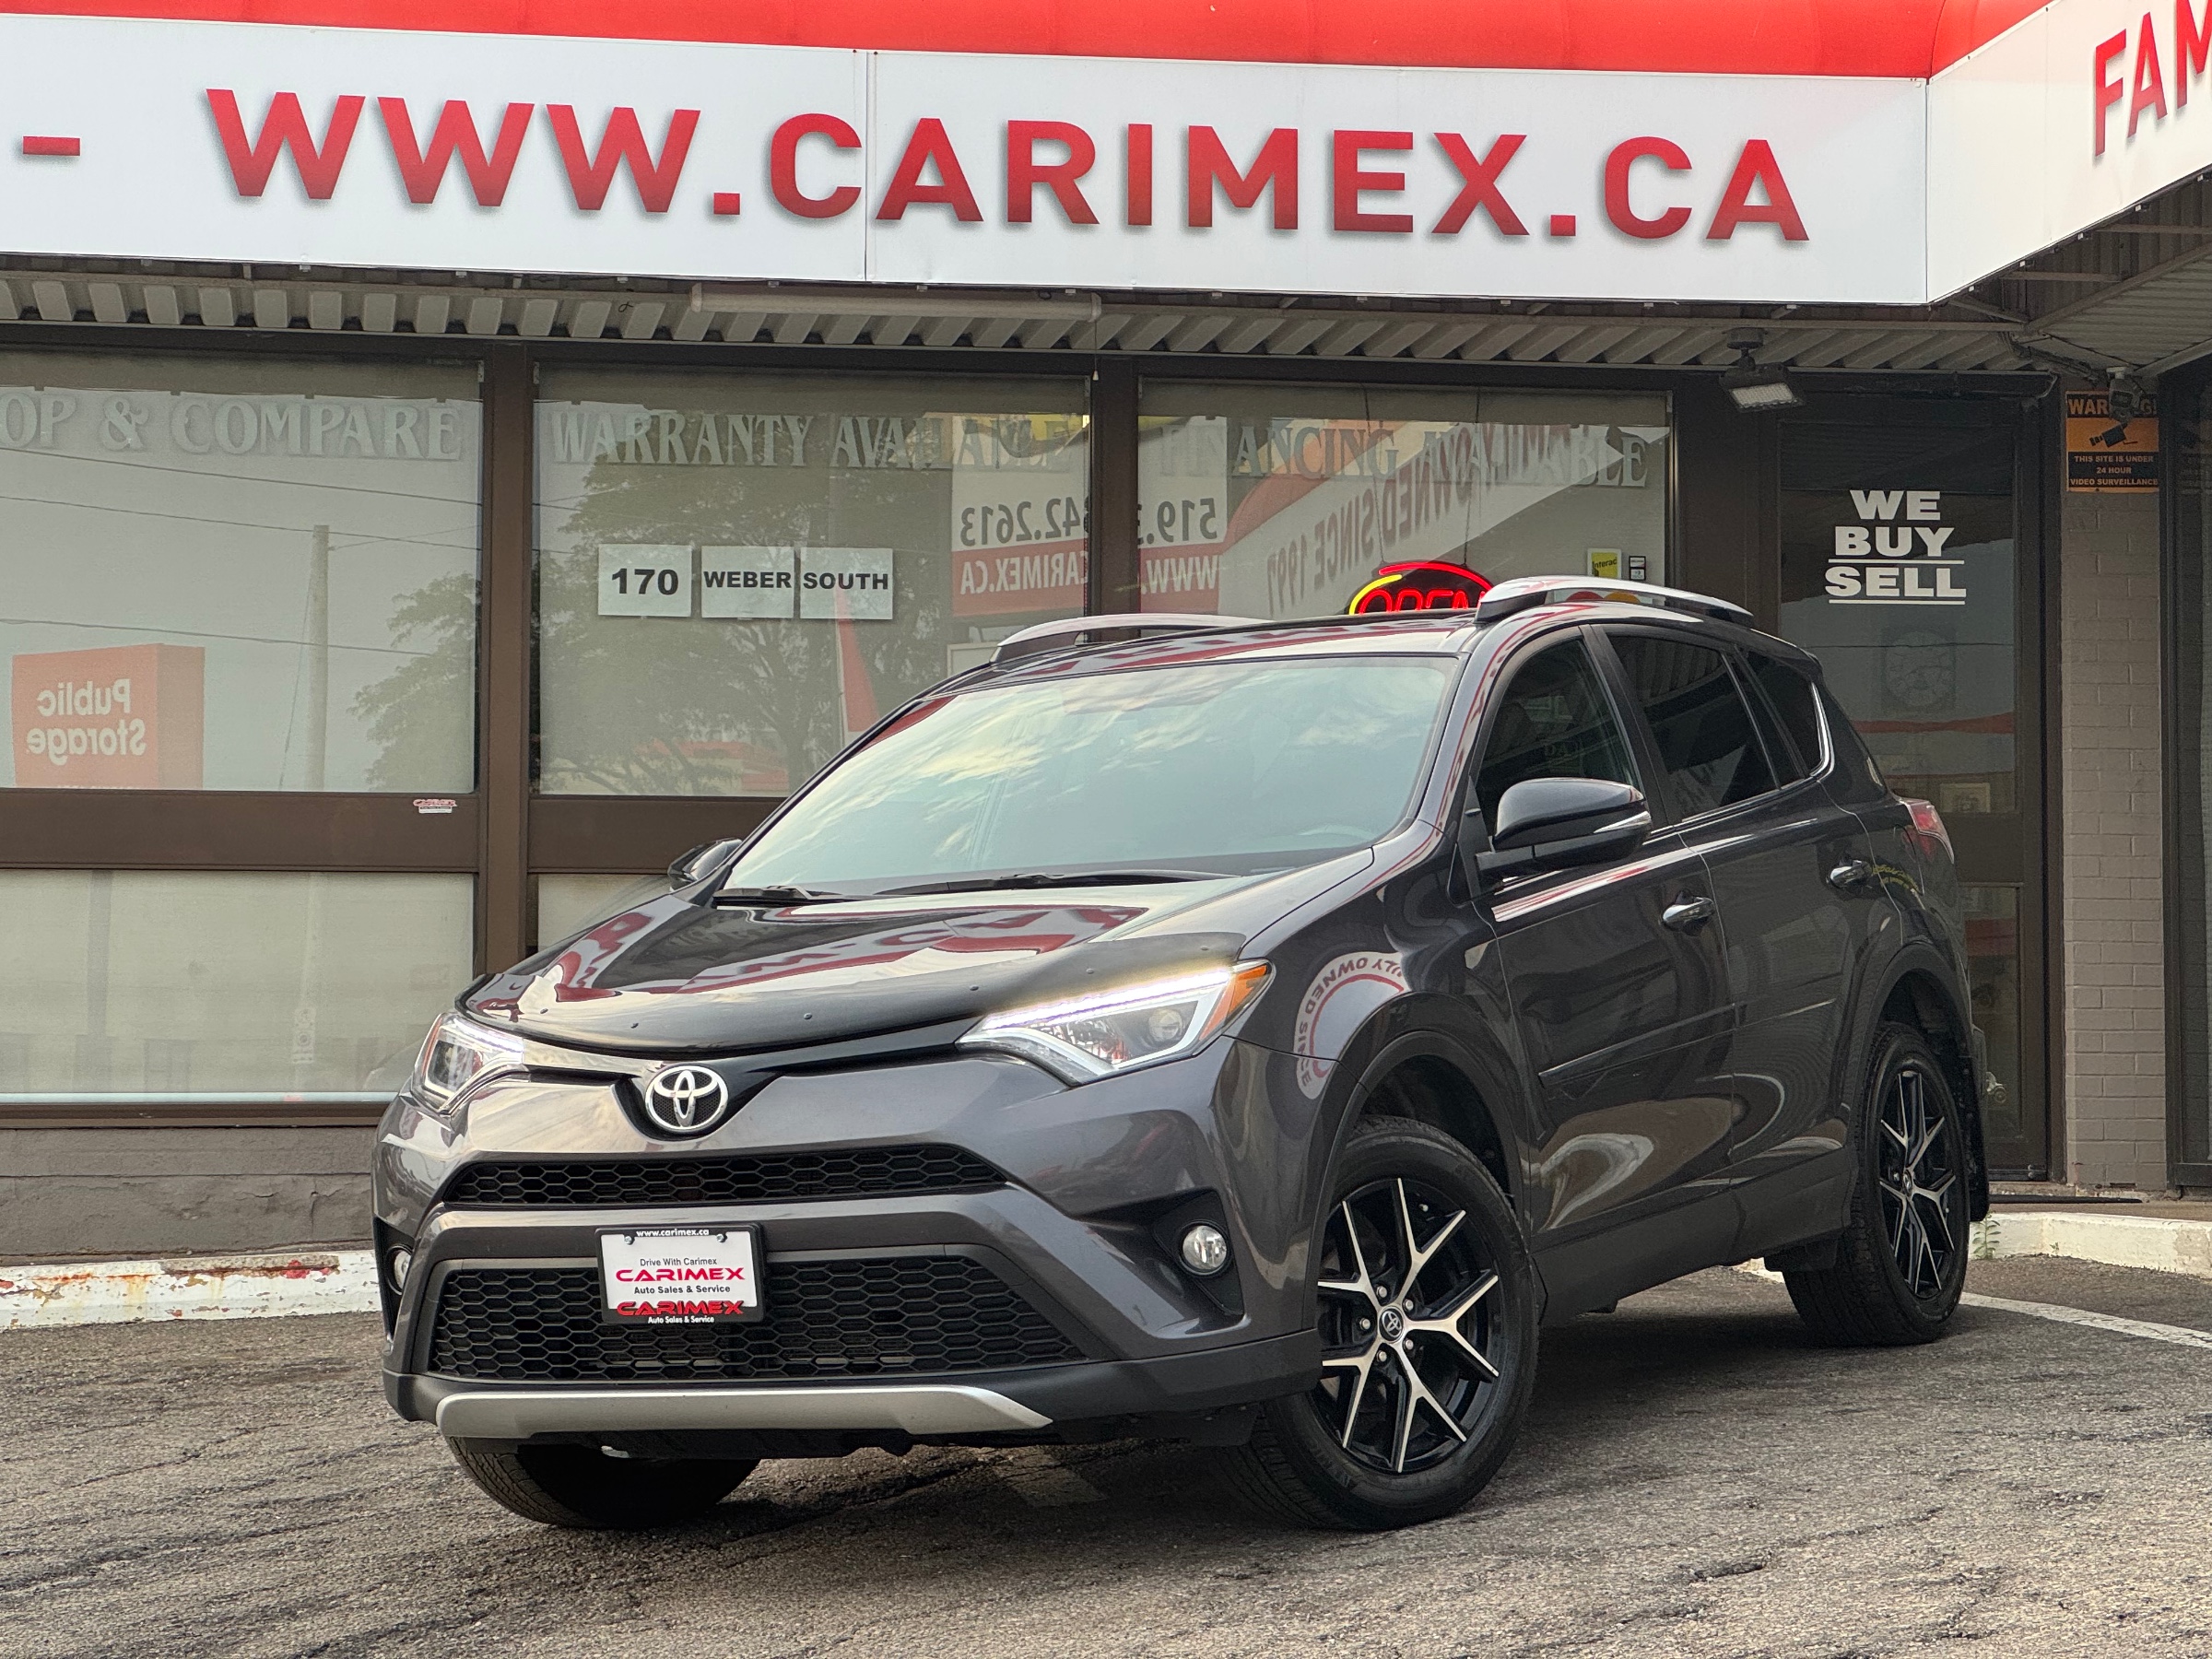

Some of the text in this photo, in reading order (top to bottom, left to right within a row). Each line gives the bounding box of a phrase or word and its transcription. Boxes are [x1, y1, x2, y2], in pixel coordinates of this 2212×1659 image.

[206, 88, 1809, 241] WWW.CARIMEX.CA
[100, 394, 149, 452] &
[171, 400, 460, 460] COMPARE
[551, 414, 814, 467] WARRANTY
[1849, 489, 1941, 521] WE
[1834, 525, 1956, 557] BUY
[611, 568, 889, 595] 170 WEBER SOUTH
[1824, 565, 1967, 597] SELL
[636, 1229, 710, 1237] www.carimex.ca
[616, 1267, 745, 1282] CARIMEX
[640, 1257, 717, 1266] Drive With Carimex
[634, 1285, 731, 1294] Auto Sales & Service
[617, 1300, 745, 1316] CARIMEX
